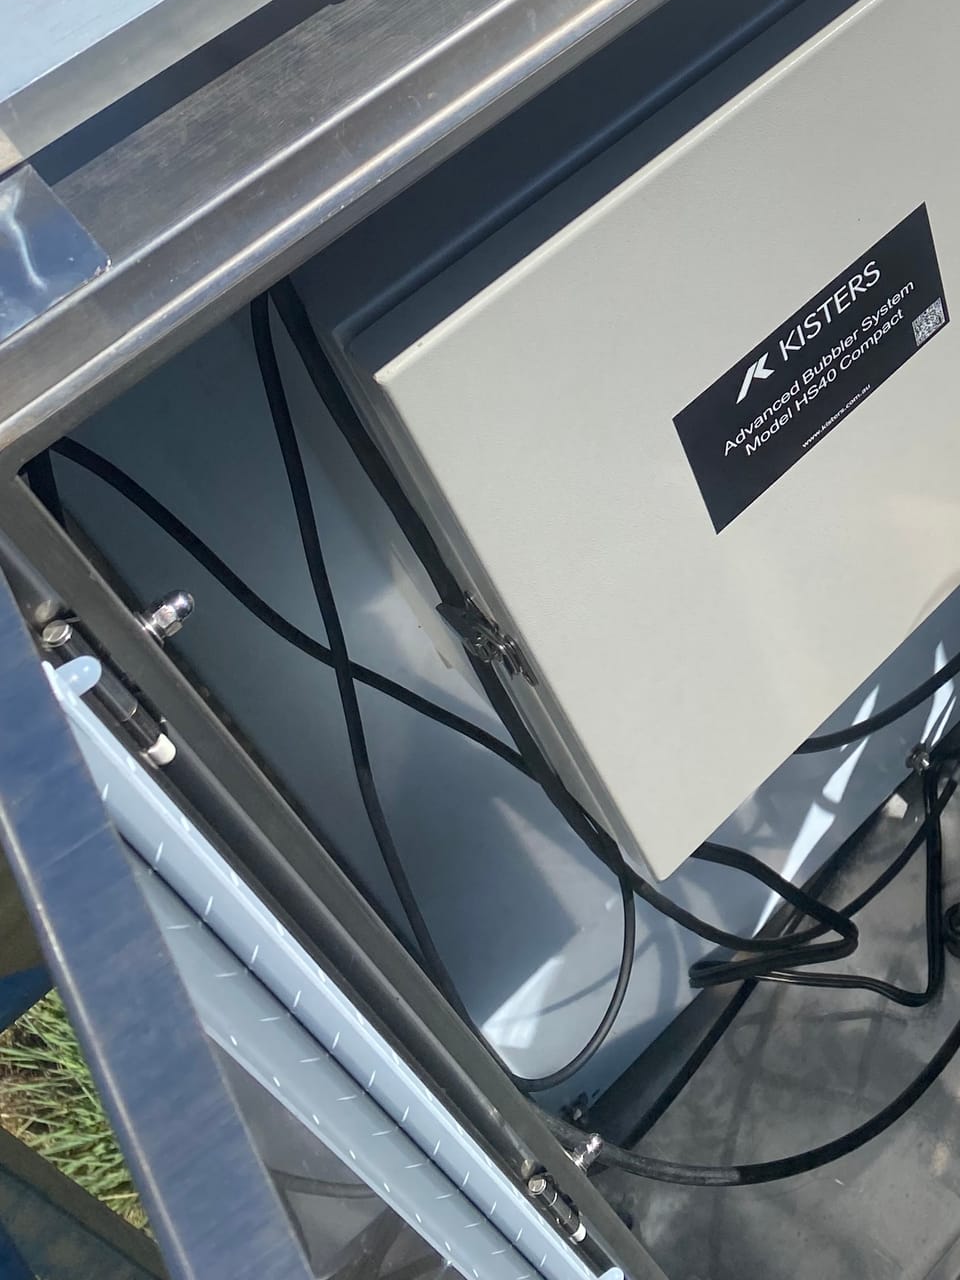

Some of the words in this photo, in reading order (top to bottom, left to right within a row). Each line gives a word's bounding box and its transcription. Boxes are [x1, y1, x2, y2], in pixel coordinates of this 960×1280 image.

[723, 380, 801, 457] Advanced
[802, 329, 859, 385] Bubbler
[861, 280, 915, 333] System
[778, 260, 881, 362] KISTERS
[744, 407, 793, 456] Model
[795, 368, 838, 412] HS40
[840, 308, 905, 371] Compact
[802, 384, 871, 448] www.kisters.com.au
